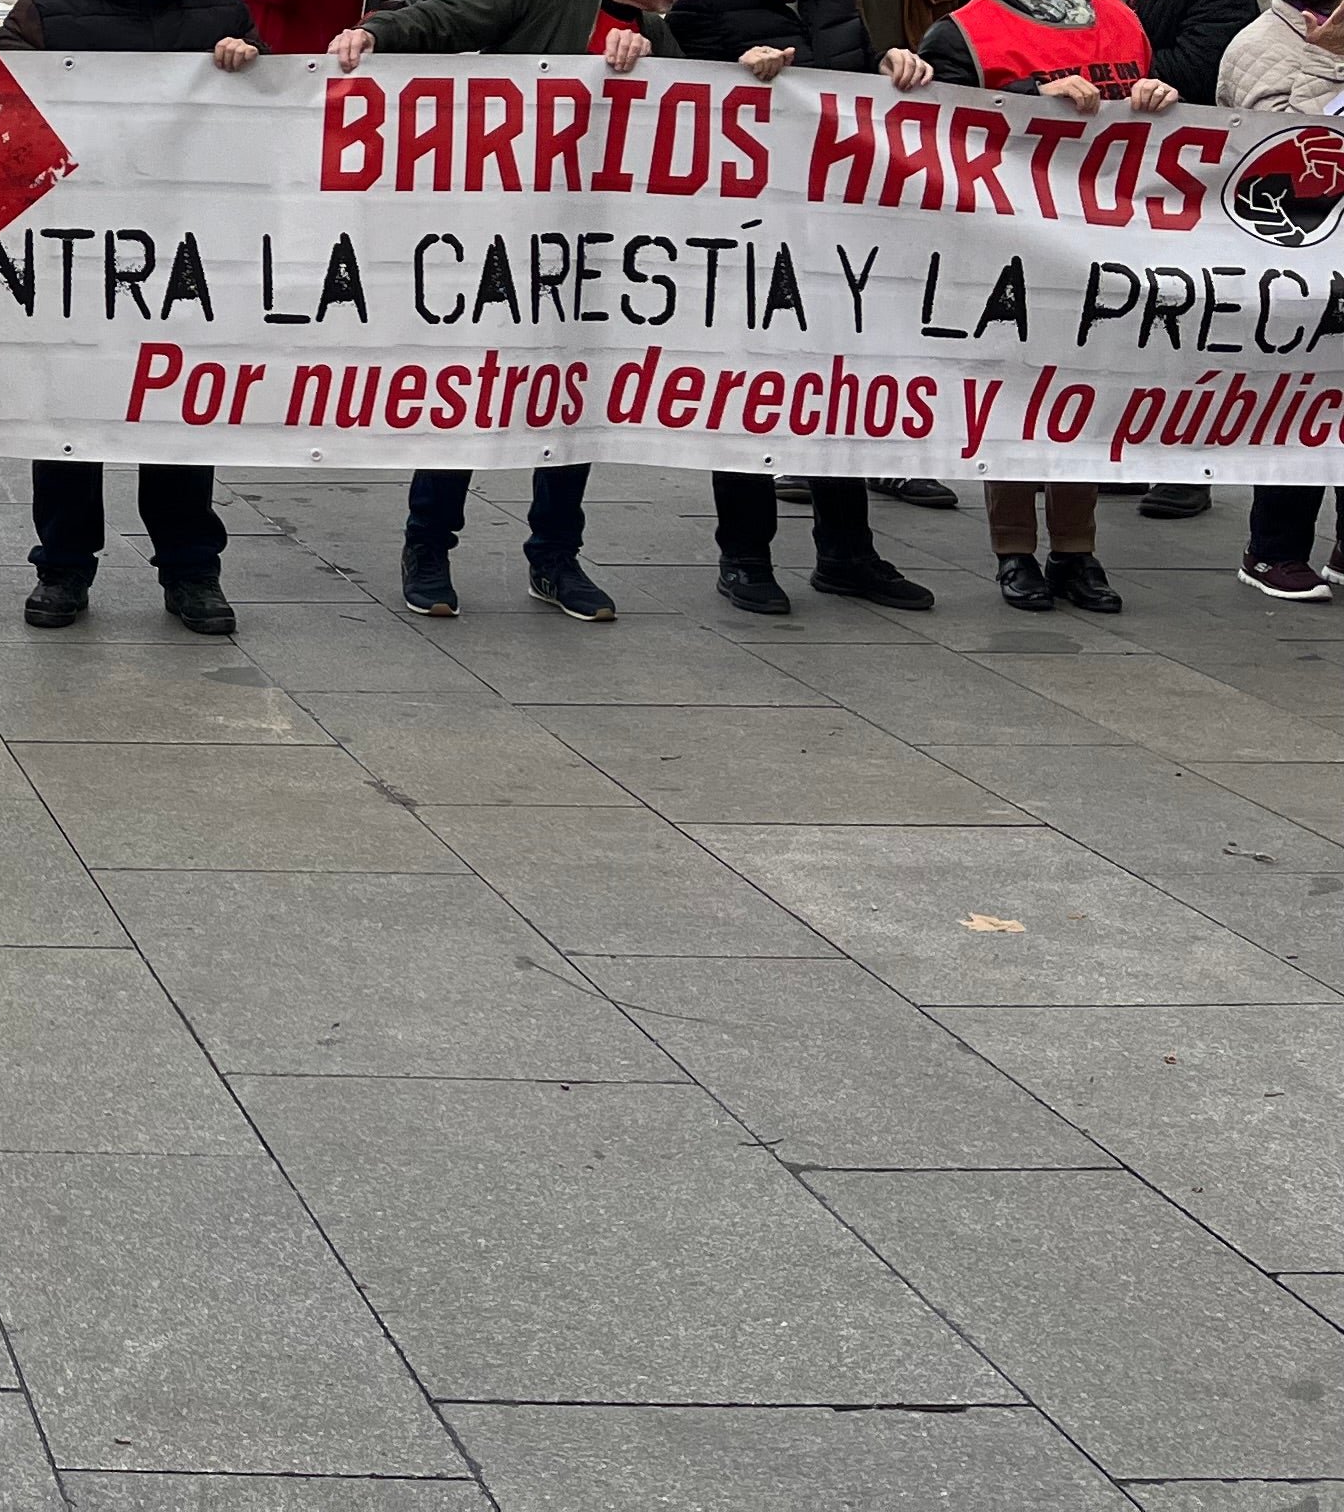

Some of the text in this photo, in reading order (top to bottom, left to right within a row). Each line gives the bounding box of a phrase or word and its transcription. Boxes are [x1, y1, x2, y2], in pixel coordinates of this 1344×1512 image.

[319, 77, 1229, 231] BARRIOS HARTOS
[262, 232, 368, 324] LA
[414, 219, 807, 332] CARESTÍA
[837, 244, 879, 333] Y
[921, 252, 1028, 342] LA
[125, 342, 1344, 463] Por nuestros derechos y lo públic
